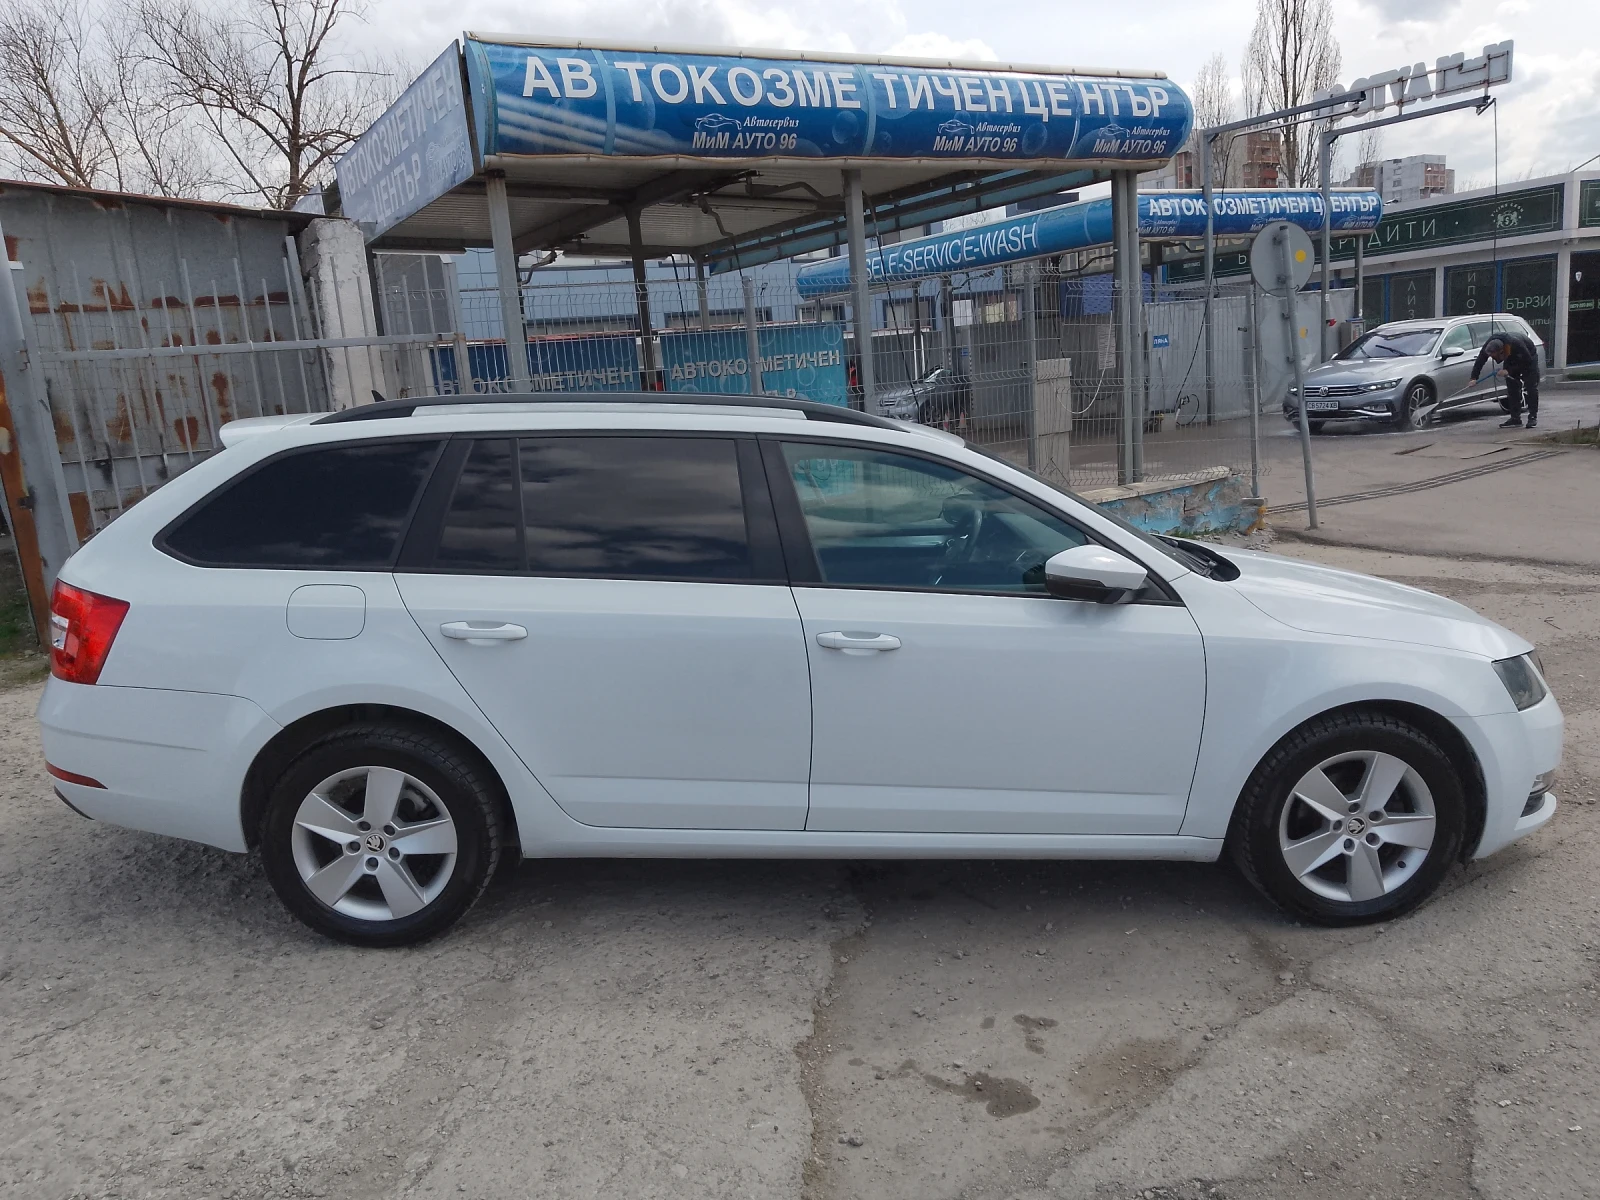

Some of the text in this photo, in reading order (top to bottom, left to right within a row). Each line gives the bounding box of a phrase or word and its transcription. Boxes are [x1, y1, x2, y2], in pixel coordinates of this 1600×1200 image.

[340, 61, 459, 200] АВТОКОЗМЕТИЧЕН
[743, 116, 799, 129] Автосервиз
[976, 122, 1021, 133] Автосервиз
[731, 132, 776, 150] АУТО
[779, 133, 797, 150] 96
[965, 137, 1001, 153] АУТО
[1002, 138, 1018, 153] 96
[1120, 139, 1151, 154] АУТО
[1152, 140, 1167, 154] 96
[372, 152, 422, 226] ЦЕНТЪР
[1329, 219, 1436, 250] РДИТИ
[1506, 294, 1551, 311] БЪРЗИ
[671, 349, 841, 381] АВТОКОМЕТИЧЕН
[1316, 402, 1329, 410] 5724
